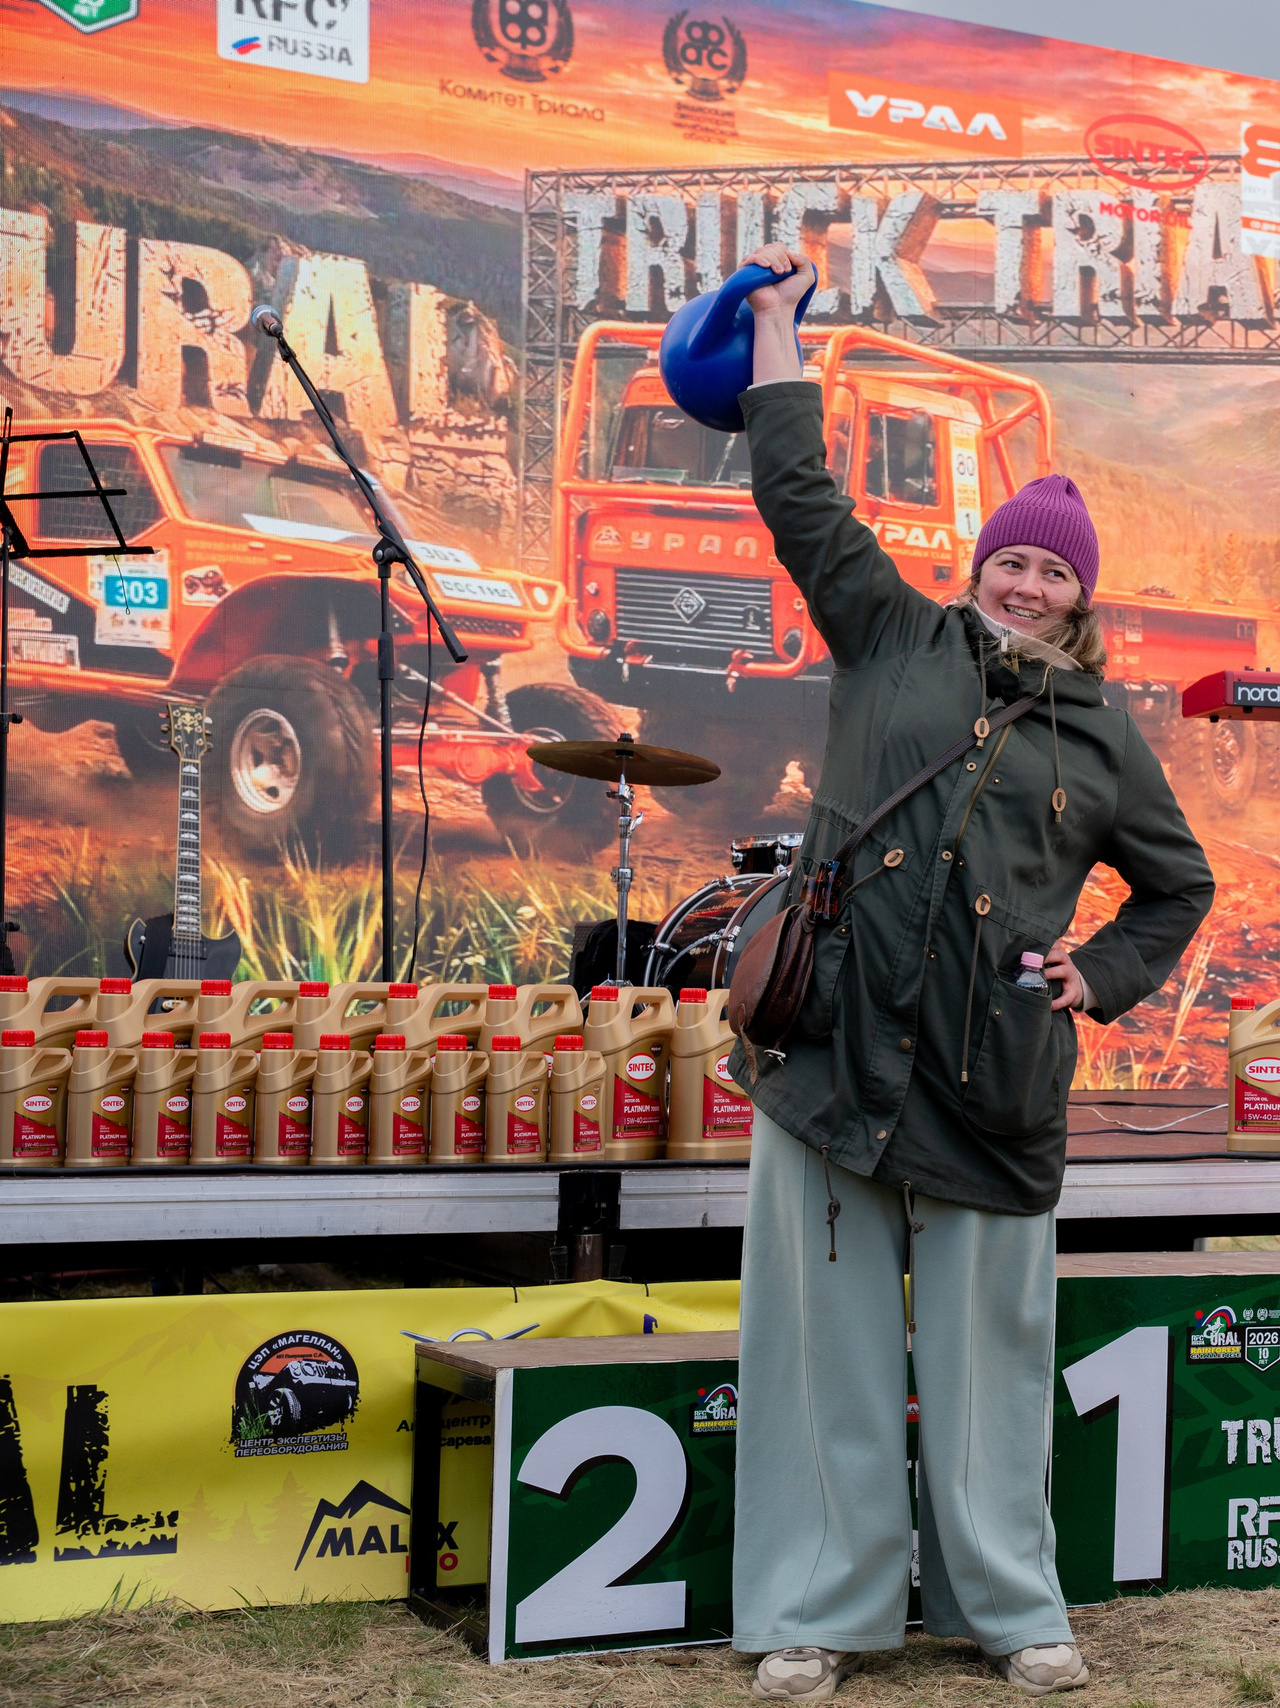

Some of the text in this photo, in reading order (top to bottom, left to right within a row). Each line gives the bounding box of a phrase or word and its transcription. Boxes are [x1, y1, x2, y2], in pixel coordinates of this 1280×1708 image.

[268, 34, 353, 65] RUSSIA
[440, 78, 605, 122] Комитет Триала
[845, 89, 1008, 141] УРАЛ
[1094, 133, 1200, 172] SINTEC
[1099, 200, 1193, 230] MOTOR OIL
[630, 530, 757, 559] УРАЛ
[116, 580, 158, 604] 303
[1237, 686, 1280, 703] nord
[628, 1062, 654, 1072] SINTEC
[717, 1063, 727, 1072] SIN
[623, 1105, 650, 1113] PLATINUM
[713, 1105, 741, 1113] PLATINUM
[1210, 1331, 1241, 1346] URAL
[1249, 1332, 1279, 1345] 2026
[248, 1334, 343, 1370] ЦЭП «МАГЕЛЛАН»
[1190, 1346, 1241, 1354] RAINFOREST
[1258, 1347, 1270, 1359] 10
[713, 1406, 736, 1420] URA
[693, 1420, 738, 1428] RAINFORES
[240, 1433, 346, 1448] ЦЕНТР ЭКСПЕРТИЗЫ
[236, 1442, 348, 1457] ПЕРЕОБОРУДОВАНИЯ
[1062, 1326, 1169, 1582] 1
[517, 1406, 686, 1643] 2
[316, 1521, 459, 1558] MALX
